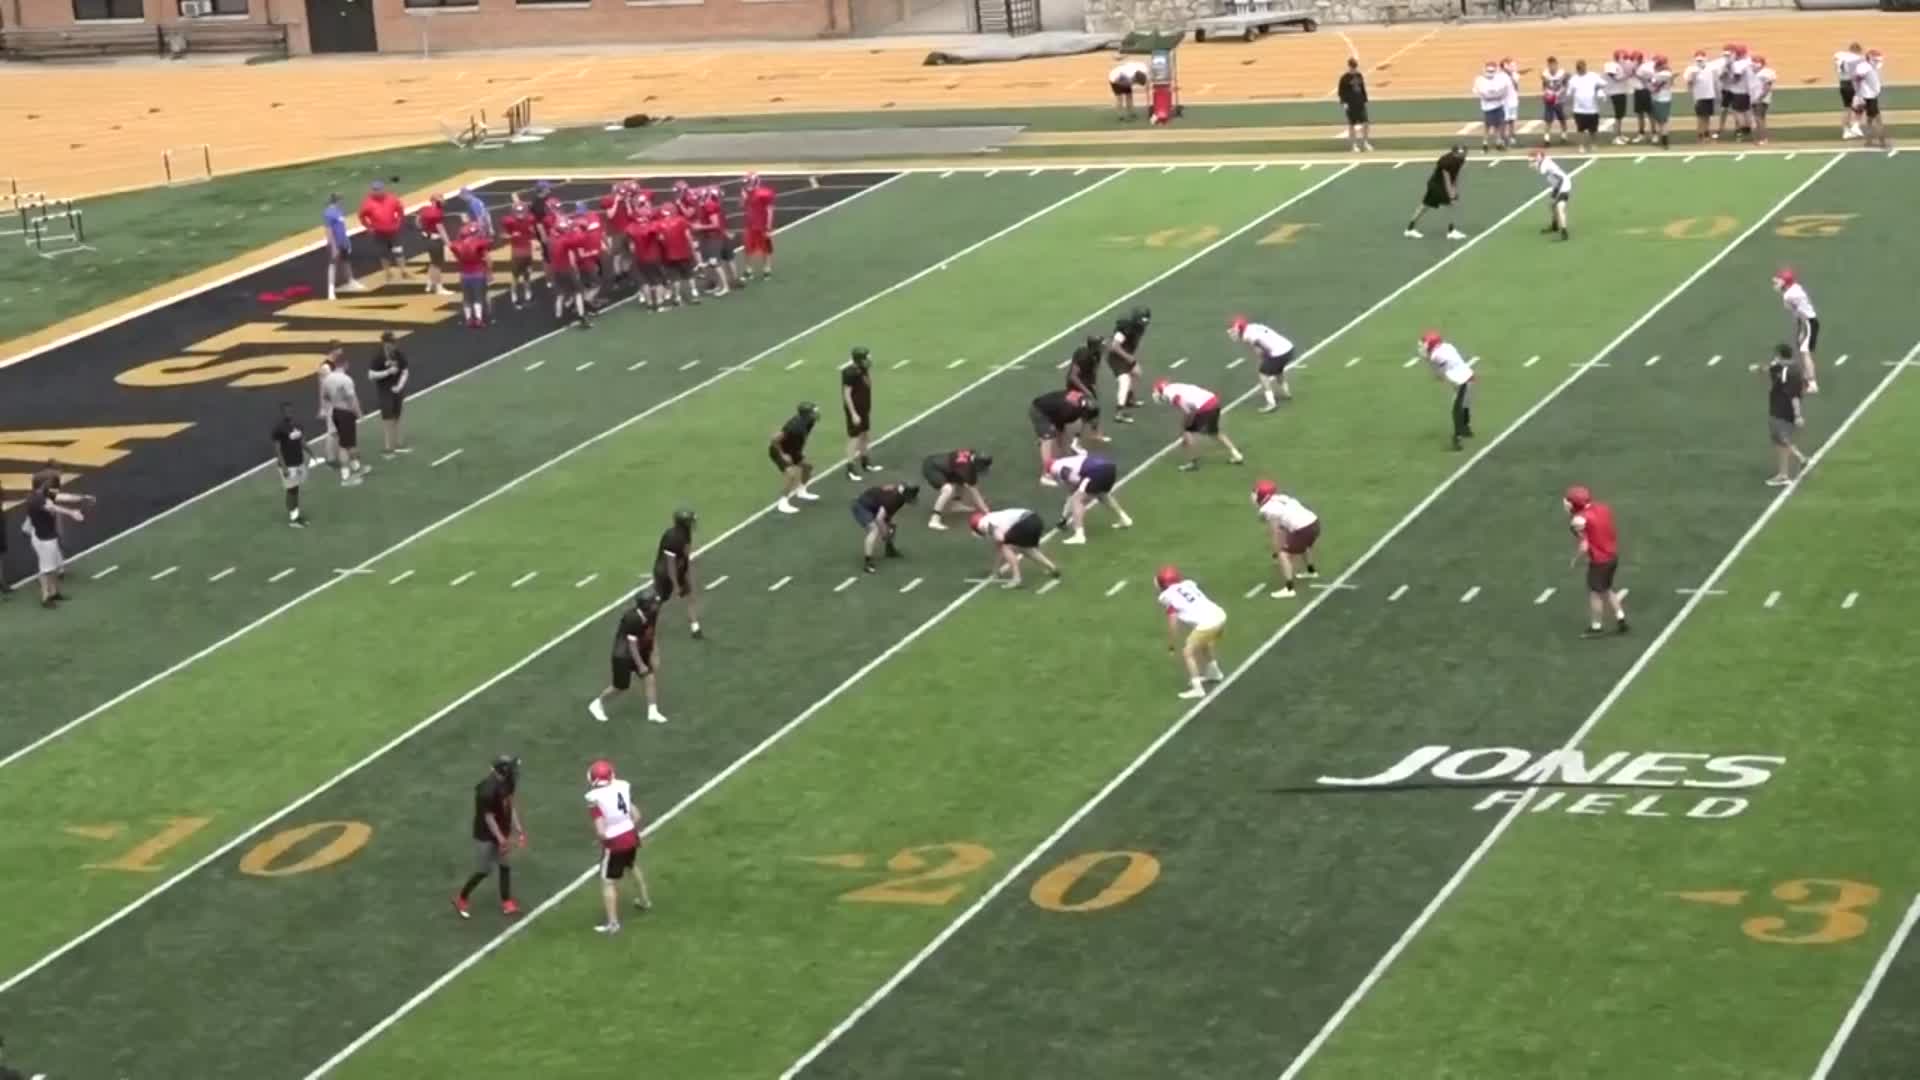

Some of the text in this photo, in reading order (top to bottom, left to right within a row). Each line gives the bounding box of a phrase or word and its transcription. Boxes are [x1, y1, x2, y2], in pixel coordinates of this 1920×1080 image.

[1316, 745, 1787, 789] JONES
[616, 791, 629, 816] 4
[1472, 788, 1750, 819] FIELD
